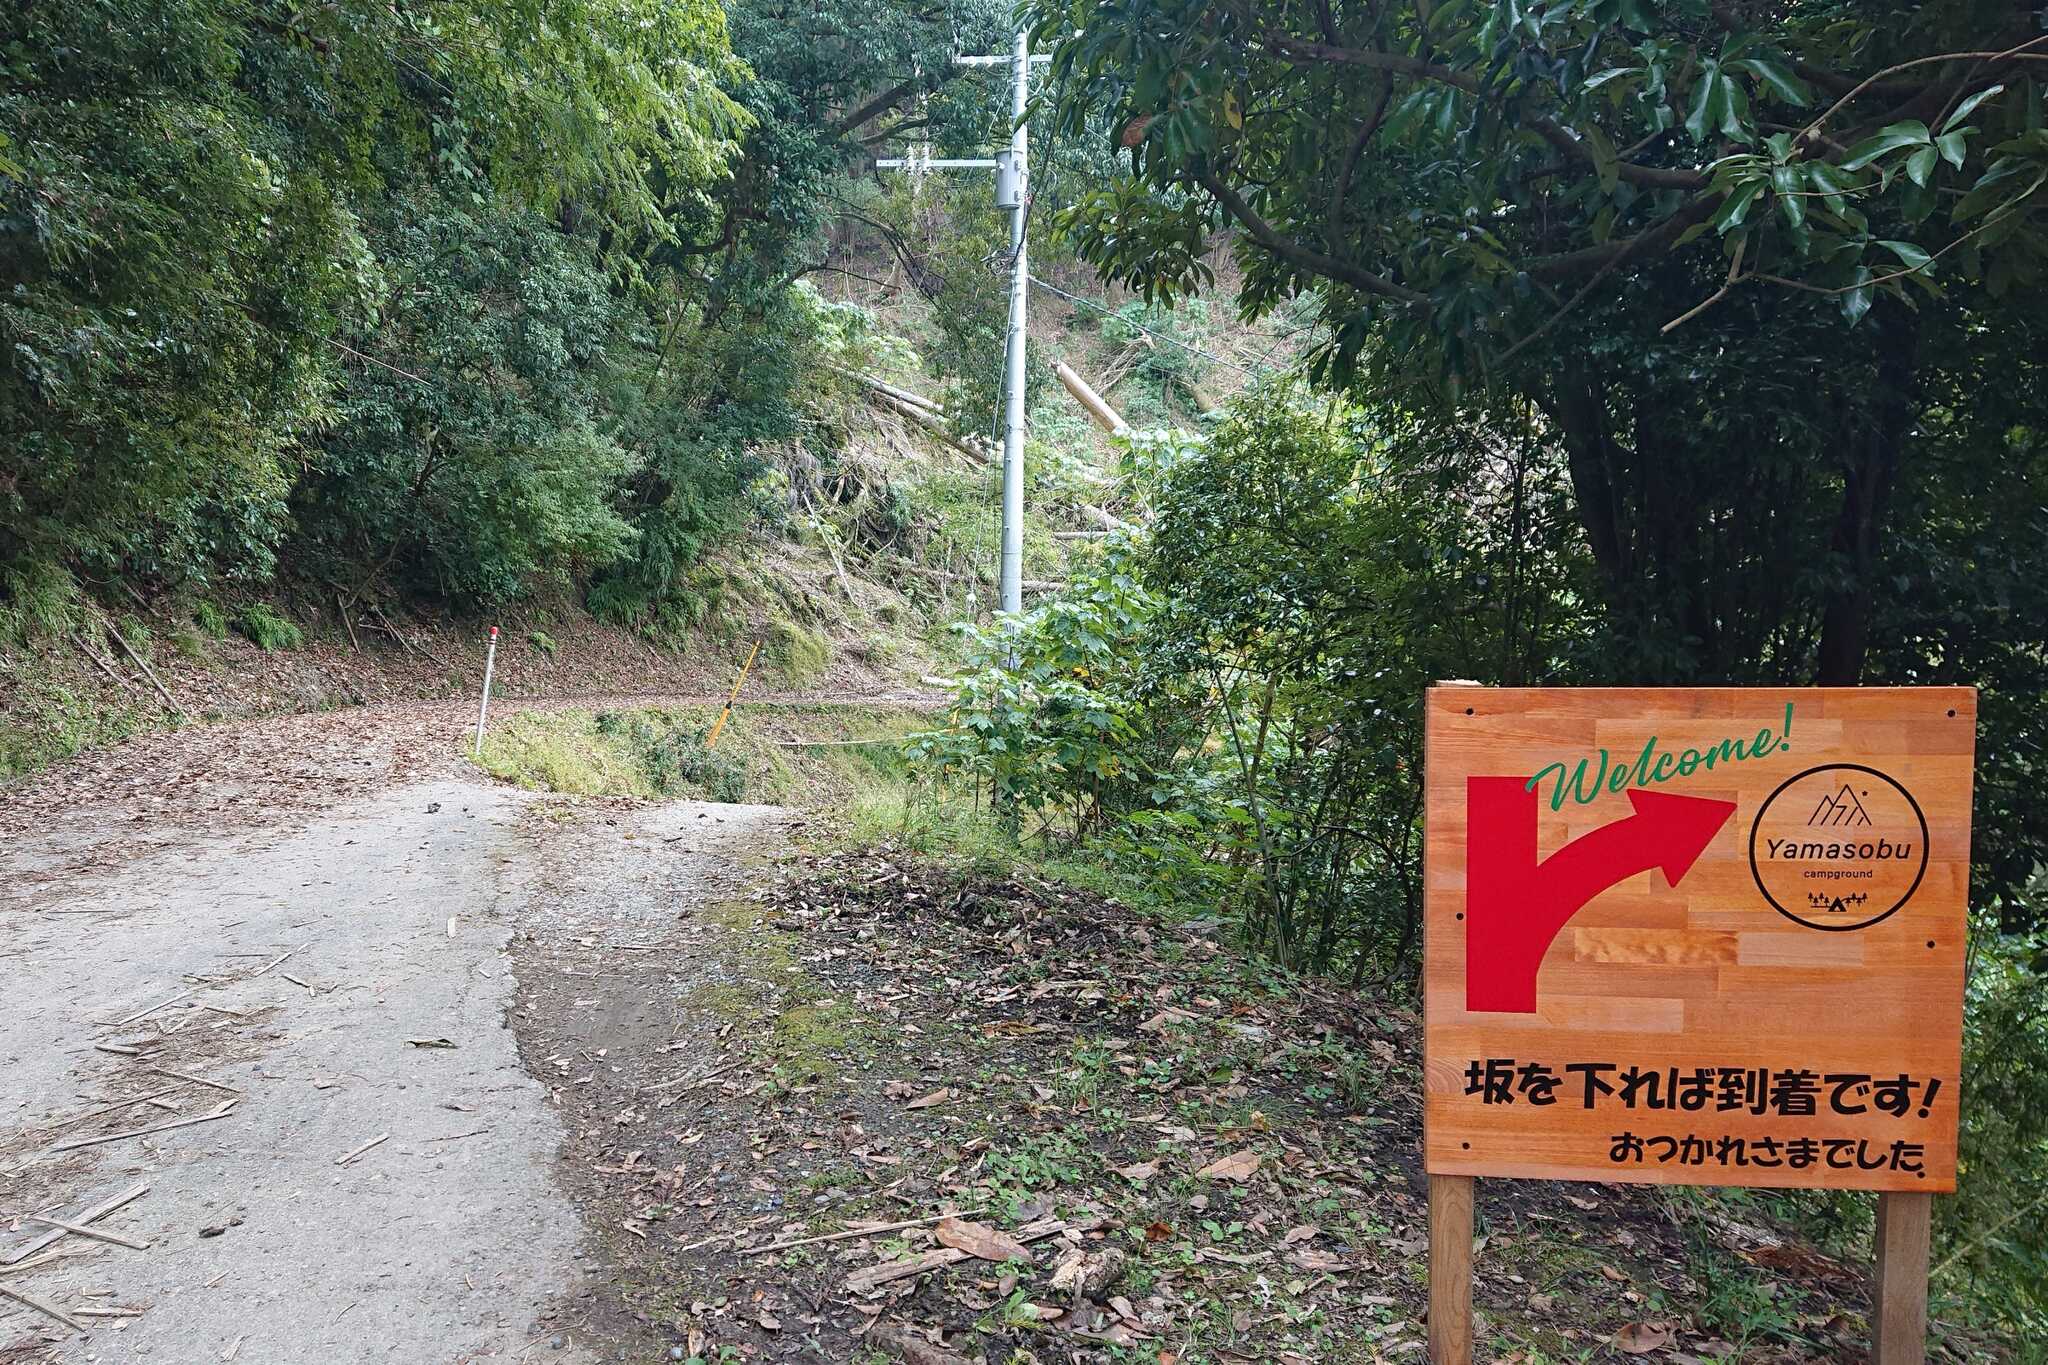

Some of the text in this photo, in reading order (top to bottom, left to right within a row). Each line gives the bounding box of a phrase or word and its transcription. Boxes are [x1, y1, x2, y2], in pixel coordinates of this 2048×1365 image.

[1525, 702, 1794, 812] Welcome!
[1767, 838, 1912, 860] Yamasobu
[1803, 869, 1873, 880] campground
